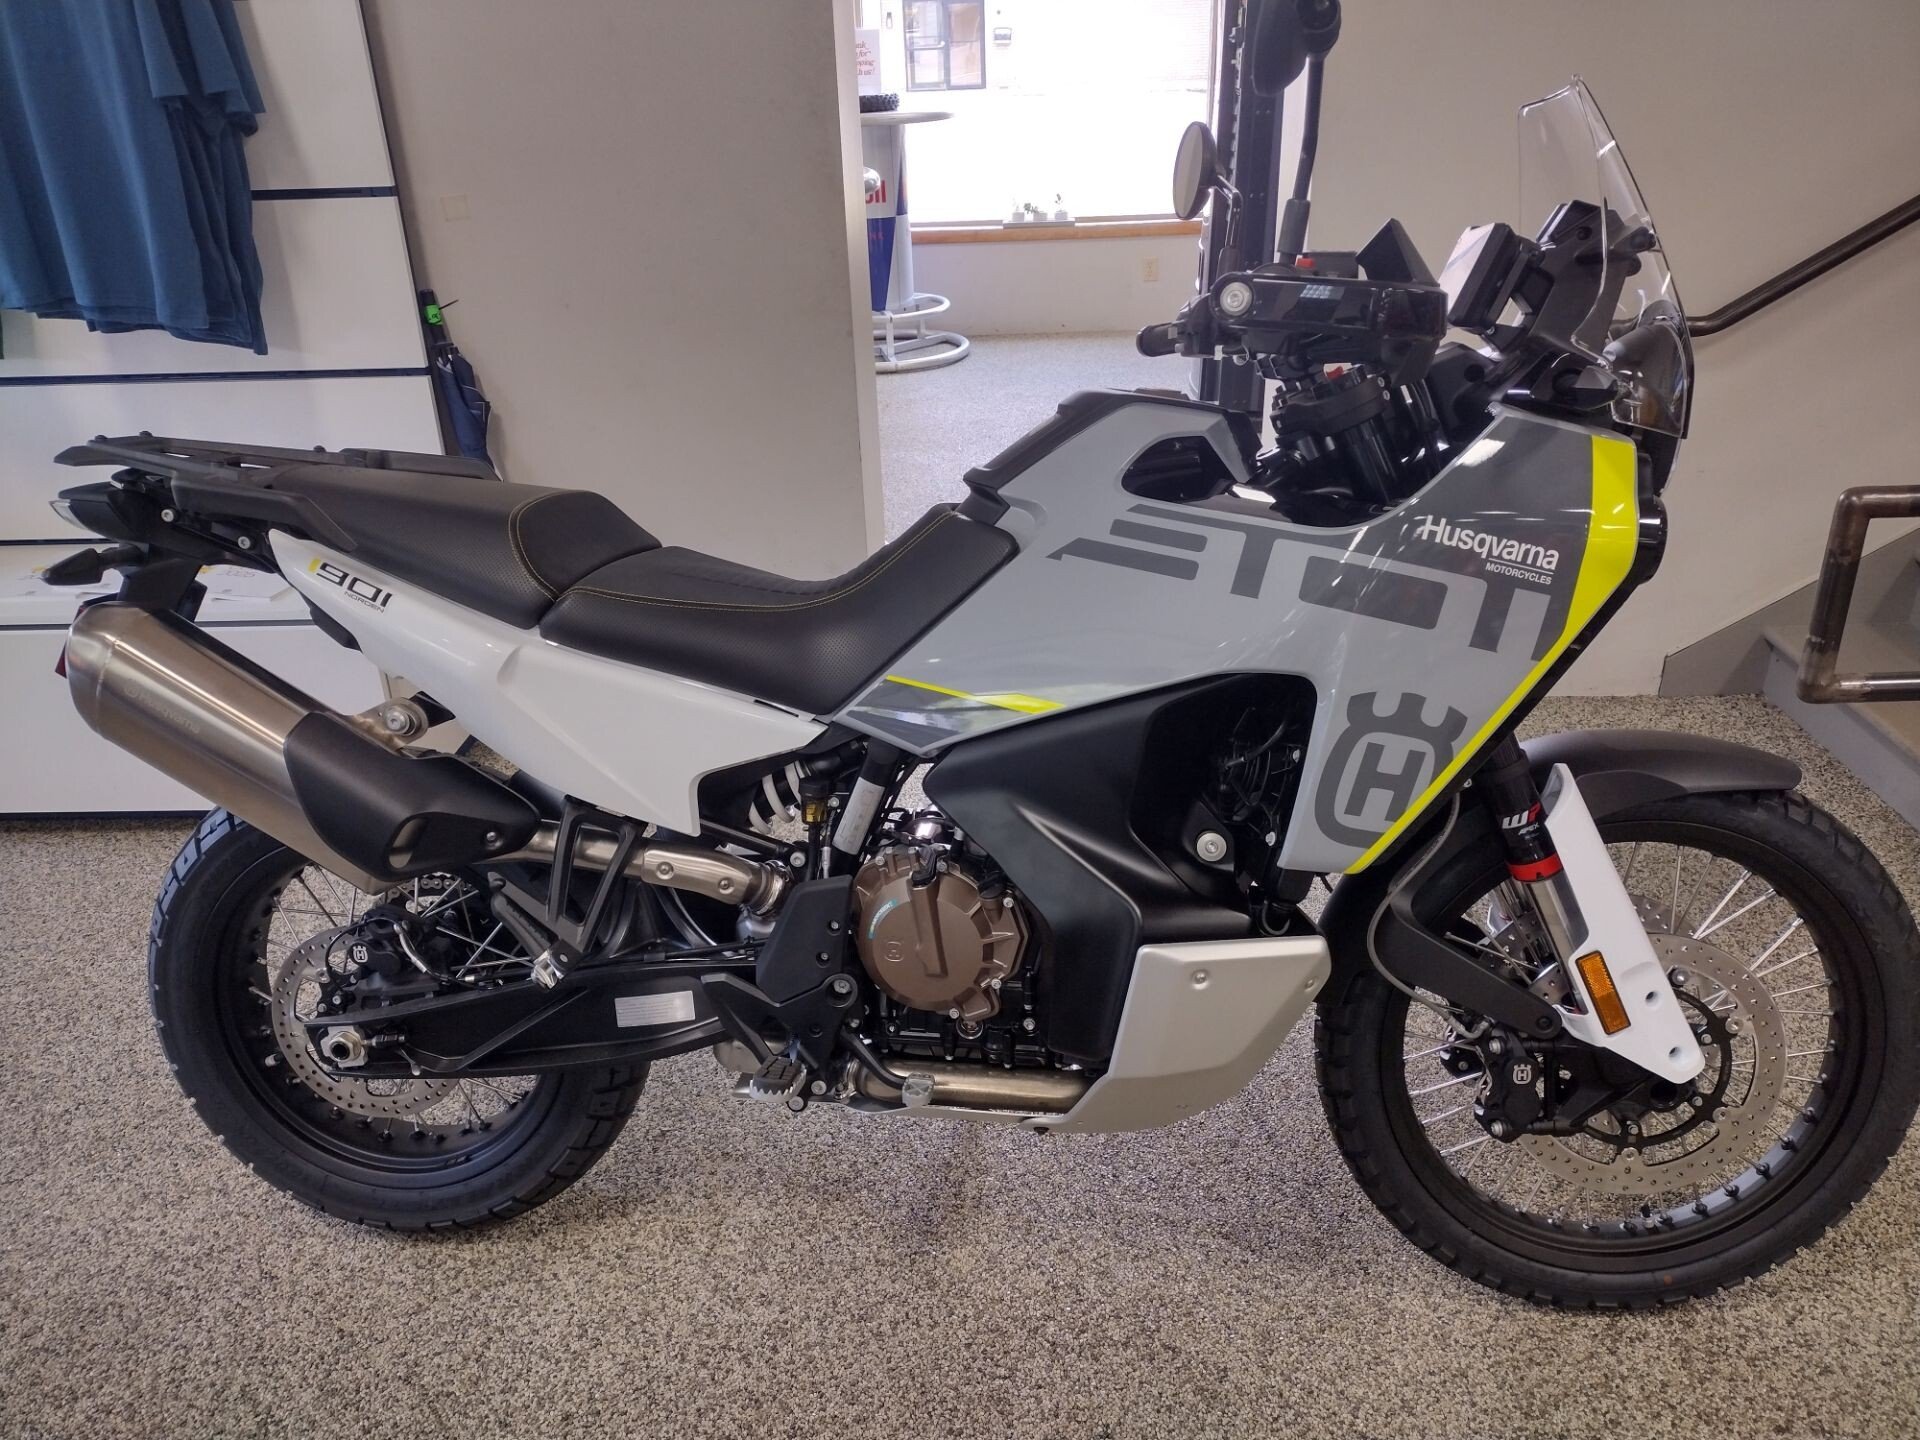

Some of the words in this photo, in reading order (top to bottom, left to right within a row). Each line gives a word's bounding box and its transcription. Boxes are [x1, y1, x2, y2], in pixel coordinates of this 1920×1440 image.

[1421, 514, 1560, 571] Husqvarna
[316, 562, 393, 608] 901
[1485, 562, 1553, 585] MOTORCYCLES
[344, 591, 385, 613] NORDEN
[1502, 801, 1542, 829] WP
